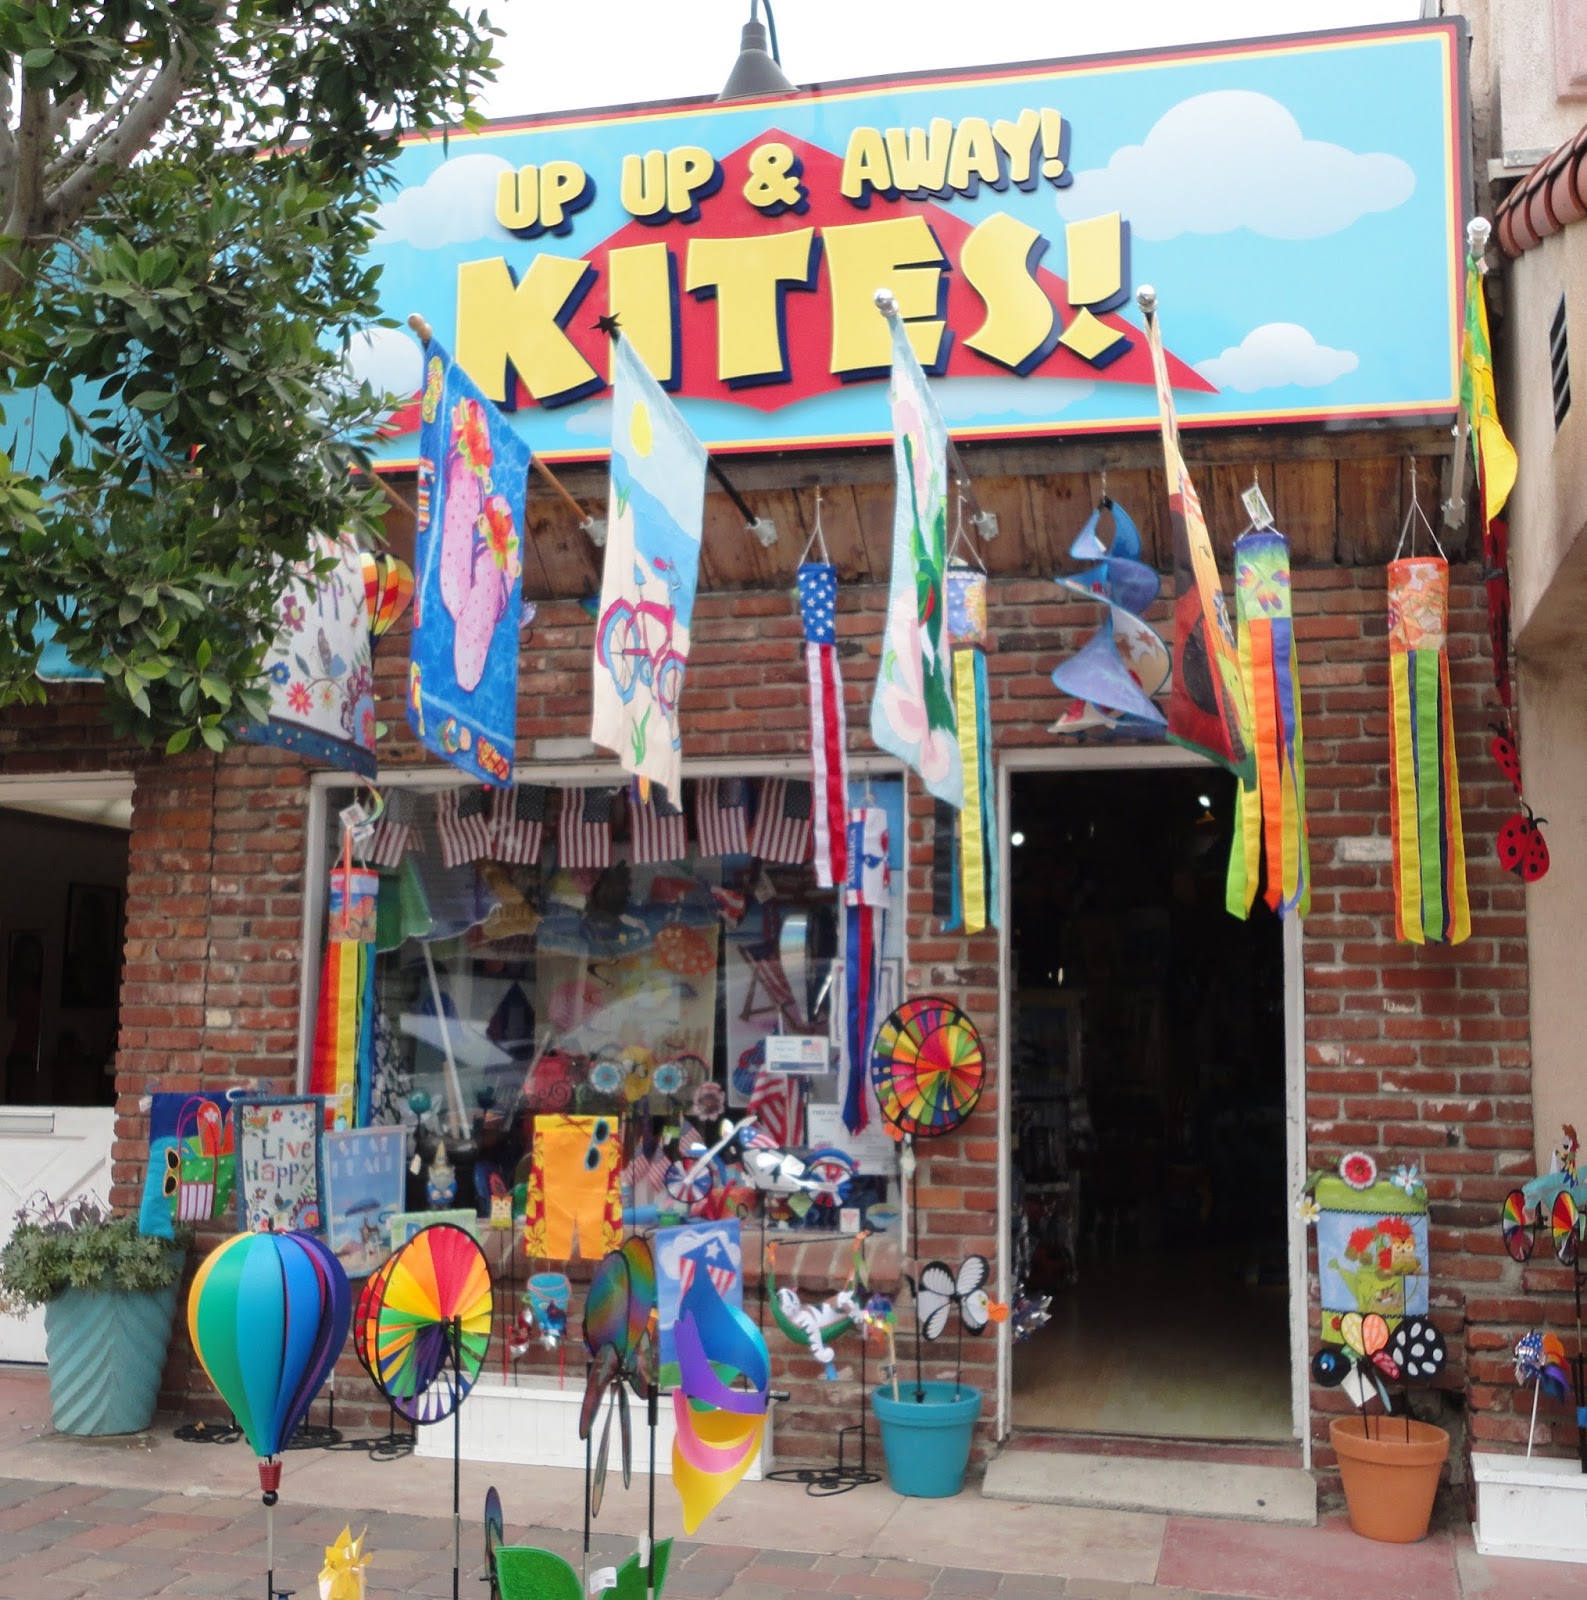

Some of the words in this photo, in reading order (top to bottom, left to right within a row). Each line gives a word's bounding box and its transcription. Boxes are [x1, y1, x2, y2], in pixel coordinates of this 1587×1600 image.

[494, 160, 588, 230] UP
[619, 145, 716, 218] UP
[743, 142, 801, 209] &
[840, 107, 1066, 200] AWAY!
[456, 210, 1127, 404] KITES!
[245, 1160, 315, 1189] Happy
[262, 1137, 312, 1161] Live
